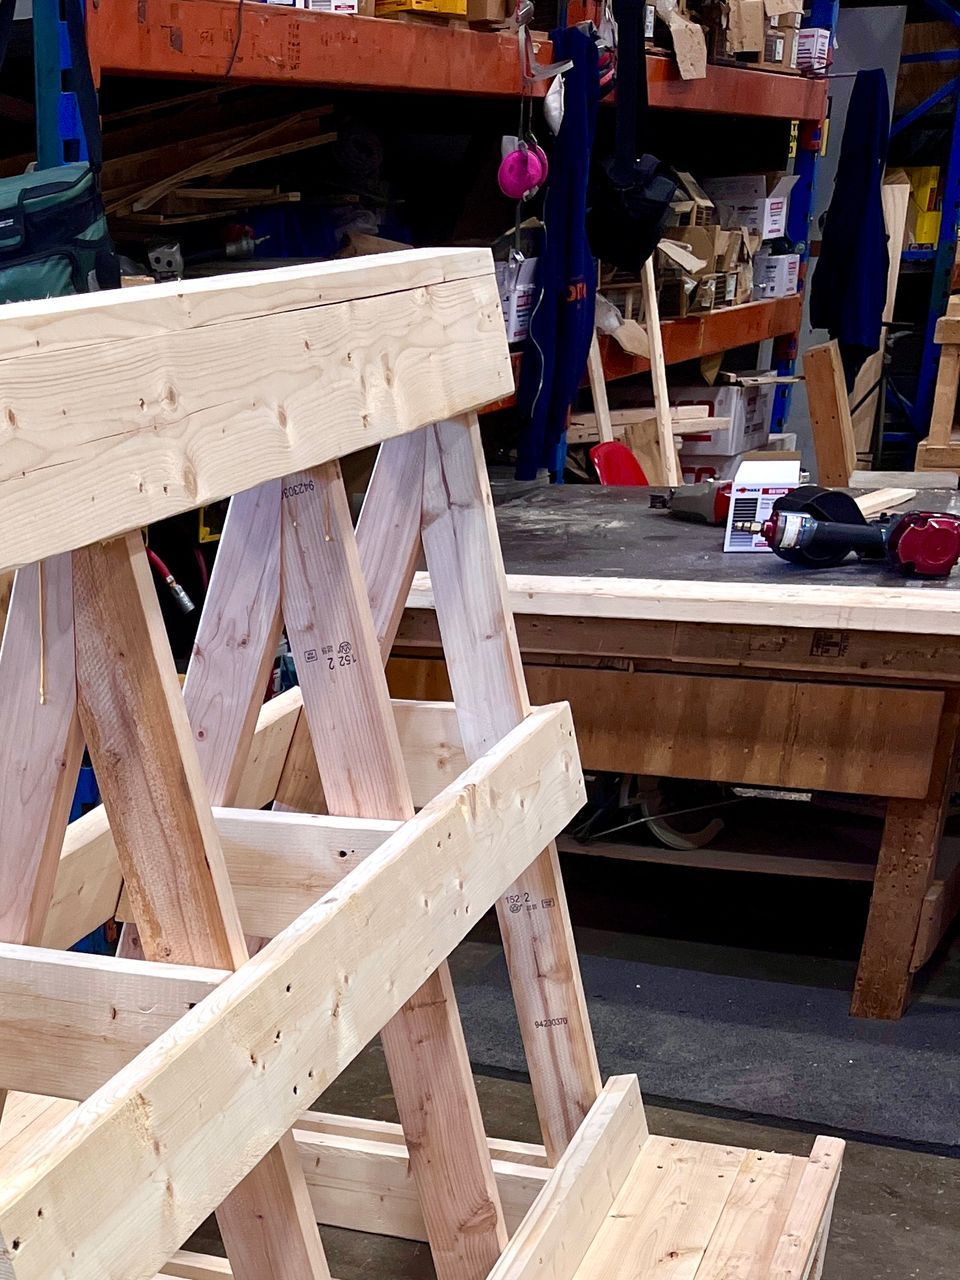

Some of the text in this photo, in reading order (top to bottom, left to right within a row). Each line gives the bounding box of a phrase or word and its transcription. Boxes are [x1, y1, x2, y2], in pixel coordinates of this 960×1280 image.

[328, 653, 357, 670] 152 2
[523, 892, 530, 903] 2
